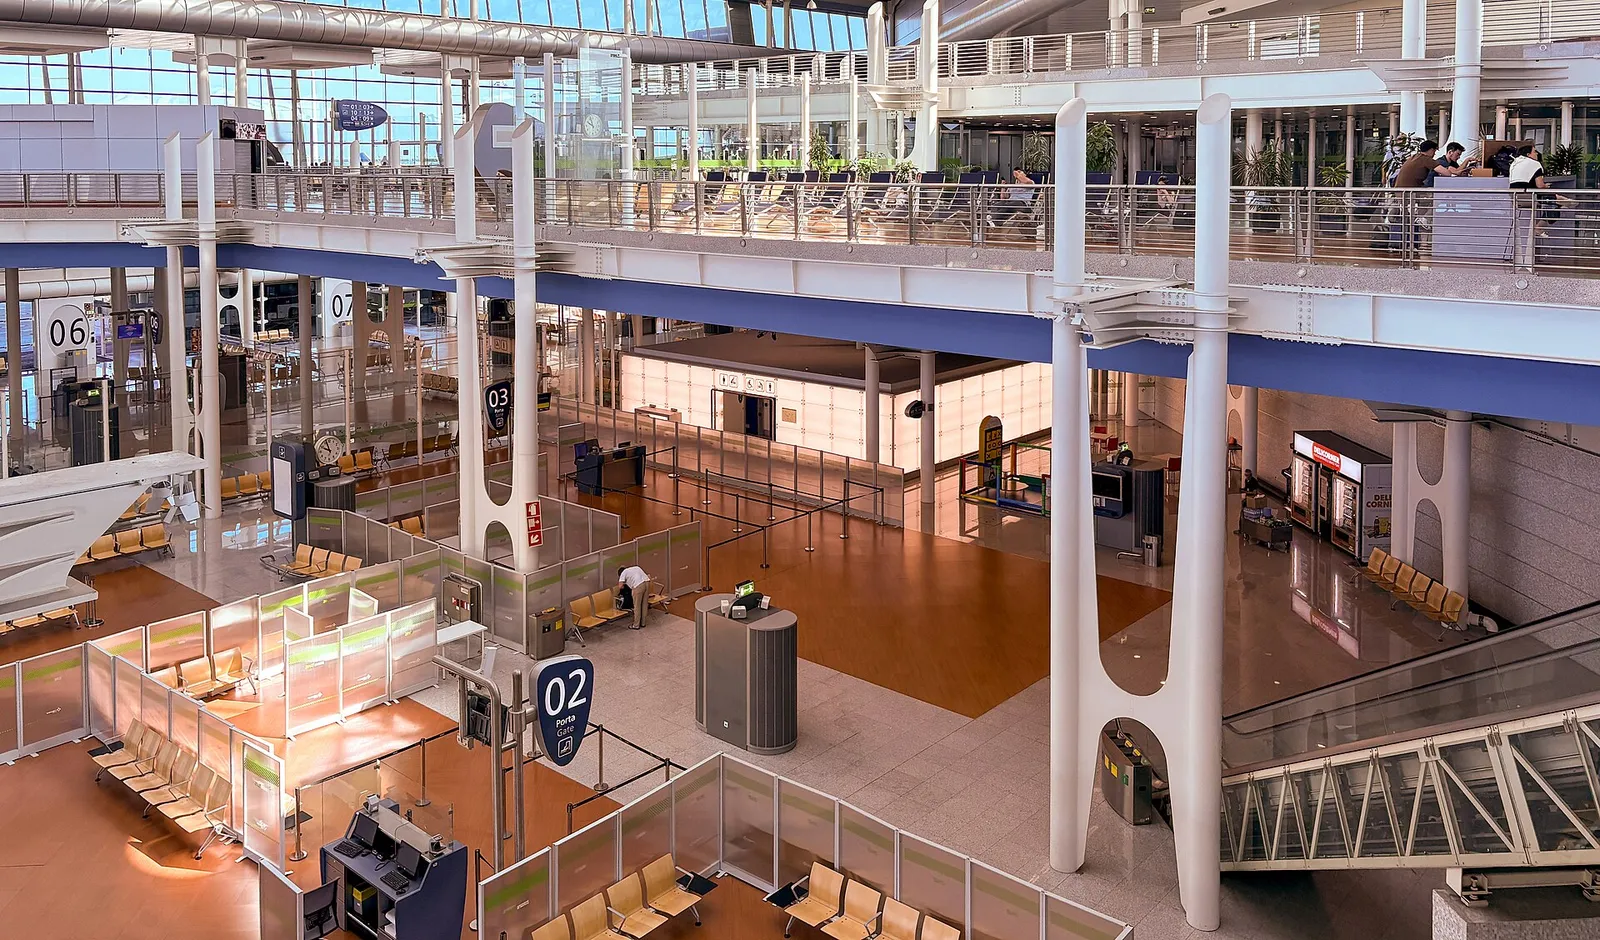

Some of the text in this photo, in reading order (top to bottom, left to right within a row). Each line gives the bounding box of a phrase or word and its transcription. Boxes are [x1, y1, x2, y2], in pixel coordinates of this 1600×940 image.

[50, 318, 85, 346] 06
[489, 388, 508, 408] 03
[545, 668, 586, 716] 02
[556, 715, 576, 728] Porta
[557, 725, 574, 737] Gate
